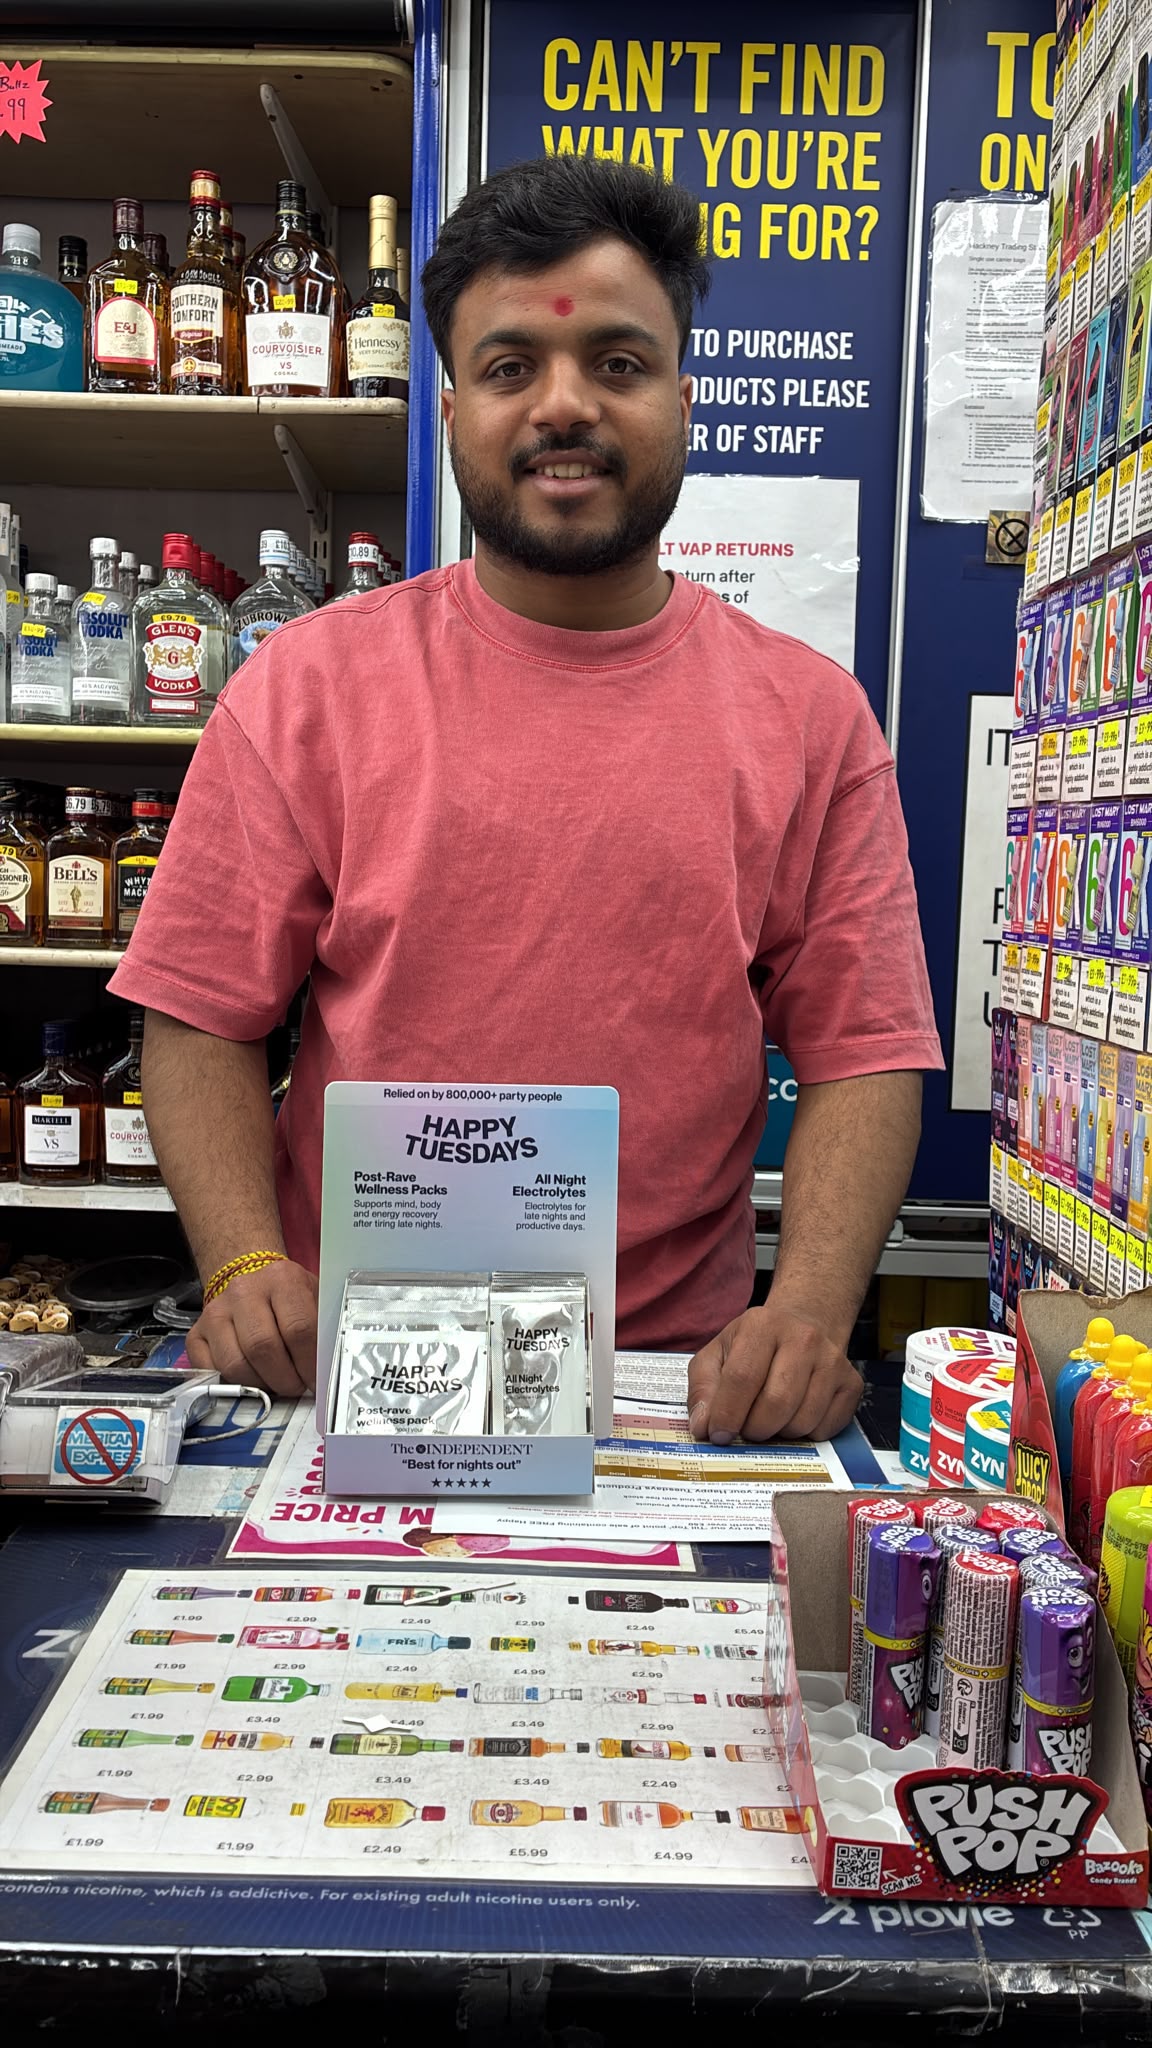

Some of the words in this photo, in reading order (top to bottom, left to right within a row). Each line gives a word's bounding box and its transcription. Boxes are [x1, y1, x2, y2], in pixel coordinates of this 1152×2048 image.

[544, 38, 720, 113] CAN'T
[740, 43, 885, 117] FIND
[697, 128, 881, 191] YOU'RE
[759, 203, 879, 261] FOR?
[1001, 242, 1026, 253] Trading
[172, 294, 219, 311] SOUTHERN
[173, 310, 216, 324] COMFORT
[114, 322, 137, 334] E&J
[252, 344, 323, 356] COURVOISIER
[354, 338, 402, 351] Hennessy
[691, 328, 720, 357] TO
[727, 329, 854, 360] PURCHASE
[280, 362, 292, 370] VS
[691, 376, 776, 407] ODUCTS
[783, 378, 870, 408] PLEASE
[716, 424, 747, 452] OF
[753, 425, 824, 454] STAFF
[679, 542, 712, 556] VAP
[716, 542, 794, 557] RETURNS
[719, 568, 755, 583] after
[734, 590, 748, 604] of
[77, 611, 129, 628] ABSOLUT
[82, 625, 123, 640] VODKA
[151, 624, 196, 637] GLEN'S
[154, 679, 194, 690] VODKA
[54, 866, 98, 881] BELL'S
[383, 1088, 416, 1100] Relied
[416, 1091, 430, 1100] on
[431, 1088, 445, 1102] by
[445, 1089, 497, 1102] 800,000+
[499, 1091, 527, 1104] party
[528, 1090, 563, 1103] people
[34, 1117, 70, 1125] MARTELL
[421, 1114, 517, 1140] HAPPY
[43, 1138, 60, 1150] VS
[405, 1134, 539, 1164] TUESDAYS
[354, 1171, 417, 1183] Post-Rave
[534, 1174, 551, 1185] All
[553, 1174, 587, 1188] Night
[354, 1183, 409, 1196] Wellness
[411, 1184, 448, 1196] Packs
[512, 1186, 587, 1200] Electrolytes
[354, 1199, 393, 1211] Supports
[394, 1200, 418, 1211] mind,
[420, 1200, 442, 1212] body
[524, 1202, 573, 1213] Electrolytes
[574, 1202, 586, 1211] for
[353, 1209, 370, 1218] and
[372, 1211, 400, 1222] energy
[402, 1211, 438, 1222] recovery
[524, 1212, 540, 1221] late
[541, 1212, 568, 1223] nights
[569, 1212, 586, 1221] and
[353, 1219, 373, 1229] after
[374, 1219, 396, 1231] tiring
[397, 1219, 413, 1229] late
[414, 1219, 443, 1231] nights.
[516, 1221, 561, 1233] productive
[562, 1222, 586, 1233] days.
[514, 1327, 560, 1340] HAPPY
[506, 1337, 571, 1352] TUESDAYS
[382, 1363, 449, 1378] HAPPY
[505, 1373, 517, 1384] All
[518, 1373, 543, 1385] Night
[370, 1377, 463, 1395] TUESDAYS
[505, 1384, 560, 1396] Electrolytes
[357, 1406, 412, 1416] Post-rave
[407, 1416, 436, 1429] pack
[57, 1430, 140, 1447] AMERICAN
[391, 1443, 415, 1455] The
[71, 1448, 141, 1466] EXPRESS
[970, 1447, 1005, 1480] ZYN
[437, 1459, 455, 1471] for
[457, 1459, 494, 1473] nights
[1016, 1448, 1049, 1496] JUICY
[269, 1502, 387, 1525] PRICE
[514, 1668, 546, 1676] £4.99
[246, 1716, 280, 1724] £3.49
[511, 1720, 545, 1728] £3.49
[641, 1723, 674, 1731] £2.99
[97, 1769, 132, 1777] £1.99
[237, 1774, 273, 1782] £2.99
[375, 1776, 411, 1784] £3.49
[642, 1780, 678, 1788] £2.49
[912, 1783, 1091, 1836] PUSH
[65, 1838, 104, 1847] £1.99
[216, 1842, 254, 1851] £1.99
[363, 1845, 401, 1854] £2.49
[509, 1848, 548, 1857] £5.99
[654, 1851, 693, 1860] £4.99
[936, 1826, 1072, 1877] POP
[1084, 1858, 1144, 1876] Bazooka
[881, 1880, 904, 1896] SCAN
[905, 1875, 922, 1889] ME
[1089, 1877, 1114, 1885] Candy
[1115, 1876, 1138, 1885] Brands
[73, 1885, 148, 1899] nicotine,
[154, 1886, 205, 1898] which
[209, 1887, 224, 1898] is
[228, 1888, 314, 1901] addictive.
[320, 1889, 348, 1901] For
[352, 1890, 421, 1904] existing
[425, 1891, 470, 1903] adult
[475, 1893, 544, 1905] nicotine
[548, 1896, 593, 1906] users
[597, 1895, 641, 1909] only.
[1068, 1929, 1088, 1940] PP
